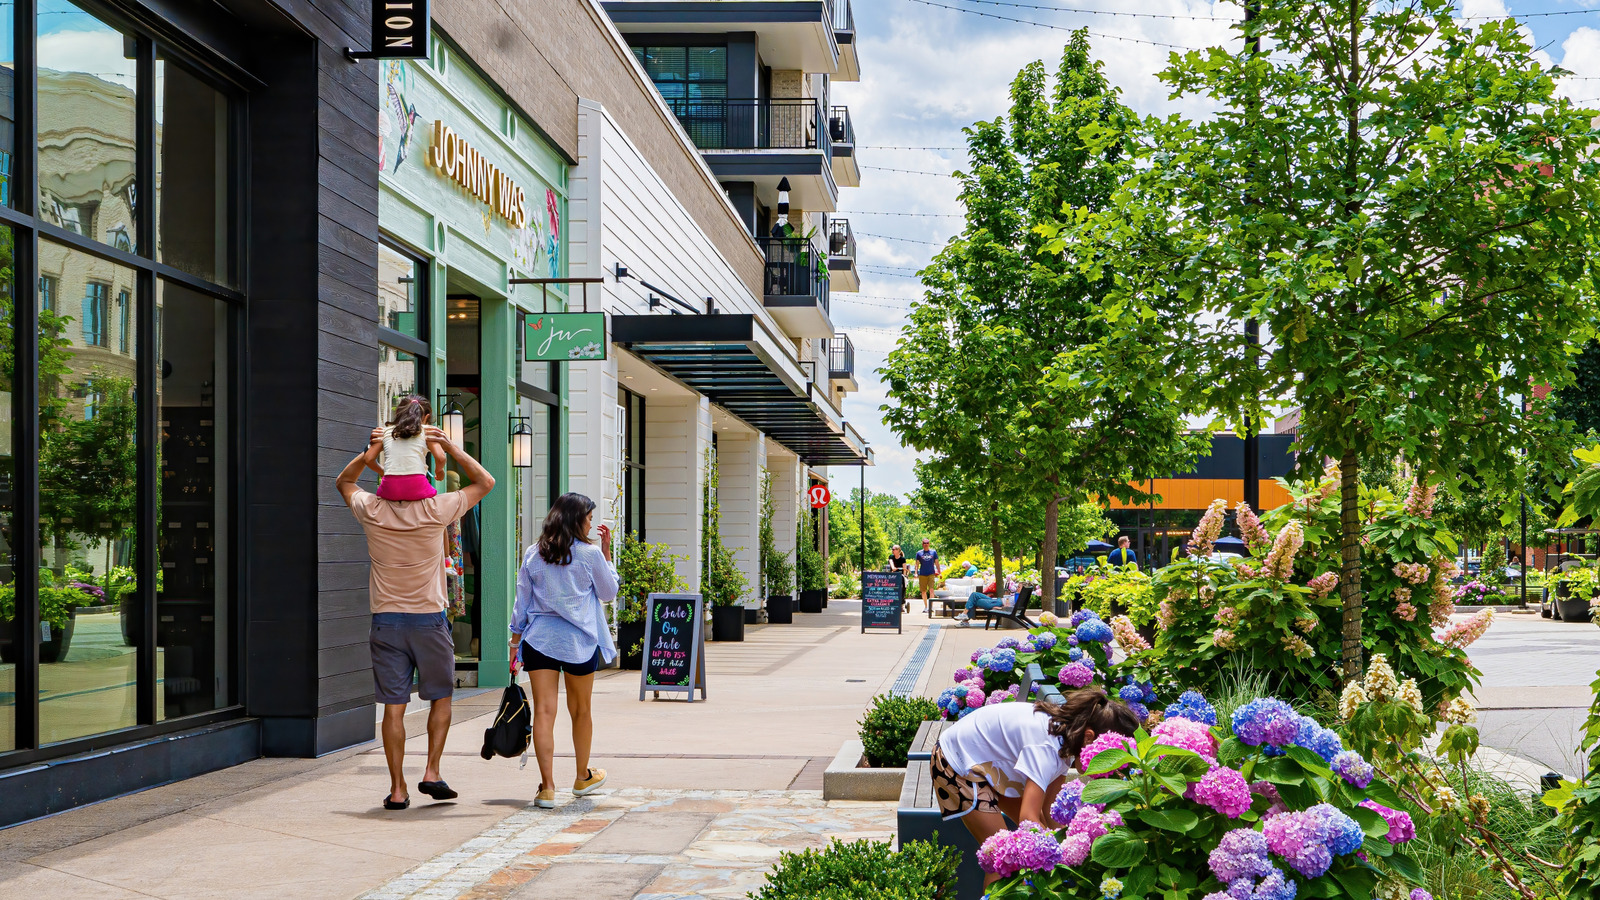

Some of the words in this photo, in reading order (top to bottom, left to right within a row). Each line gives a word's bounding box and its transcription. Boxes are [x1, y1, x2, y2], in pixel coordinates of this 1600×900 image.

[430, 120, 495, 206] JOHNNY
[496, 168, 526, 230] WAS
[661, 606, 687, 619] Sale
[662, 621, 679, 635] On
[654, 636, 680, 650] Sale
[674, 651, 686, 659] 75%
[652, 659, 666, 667] OFF
[669, 659, 684, 667] ALL
[659, 667, 677, 676] SALE
